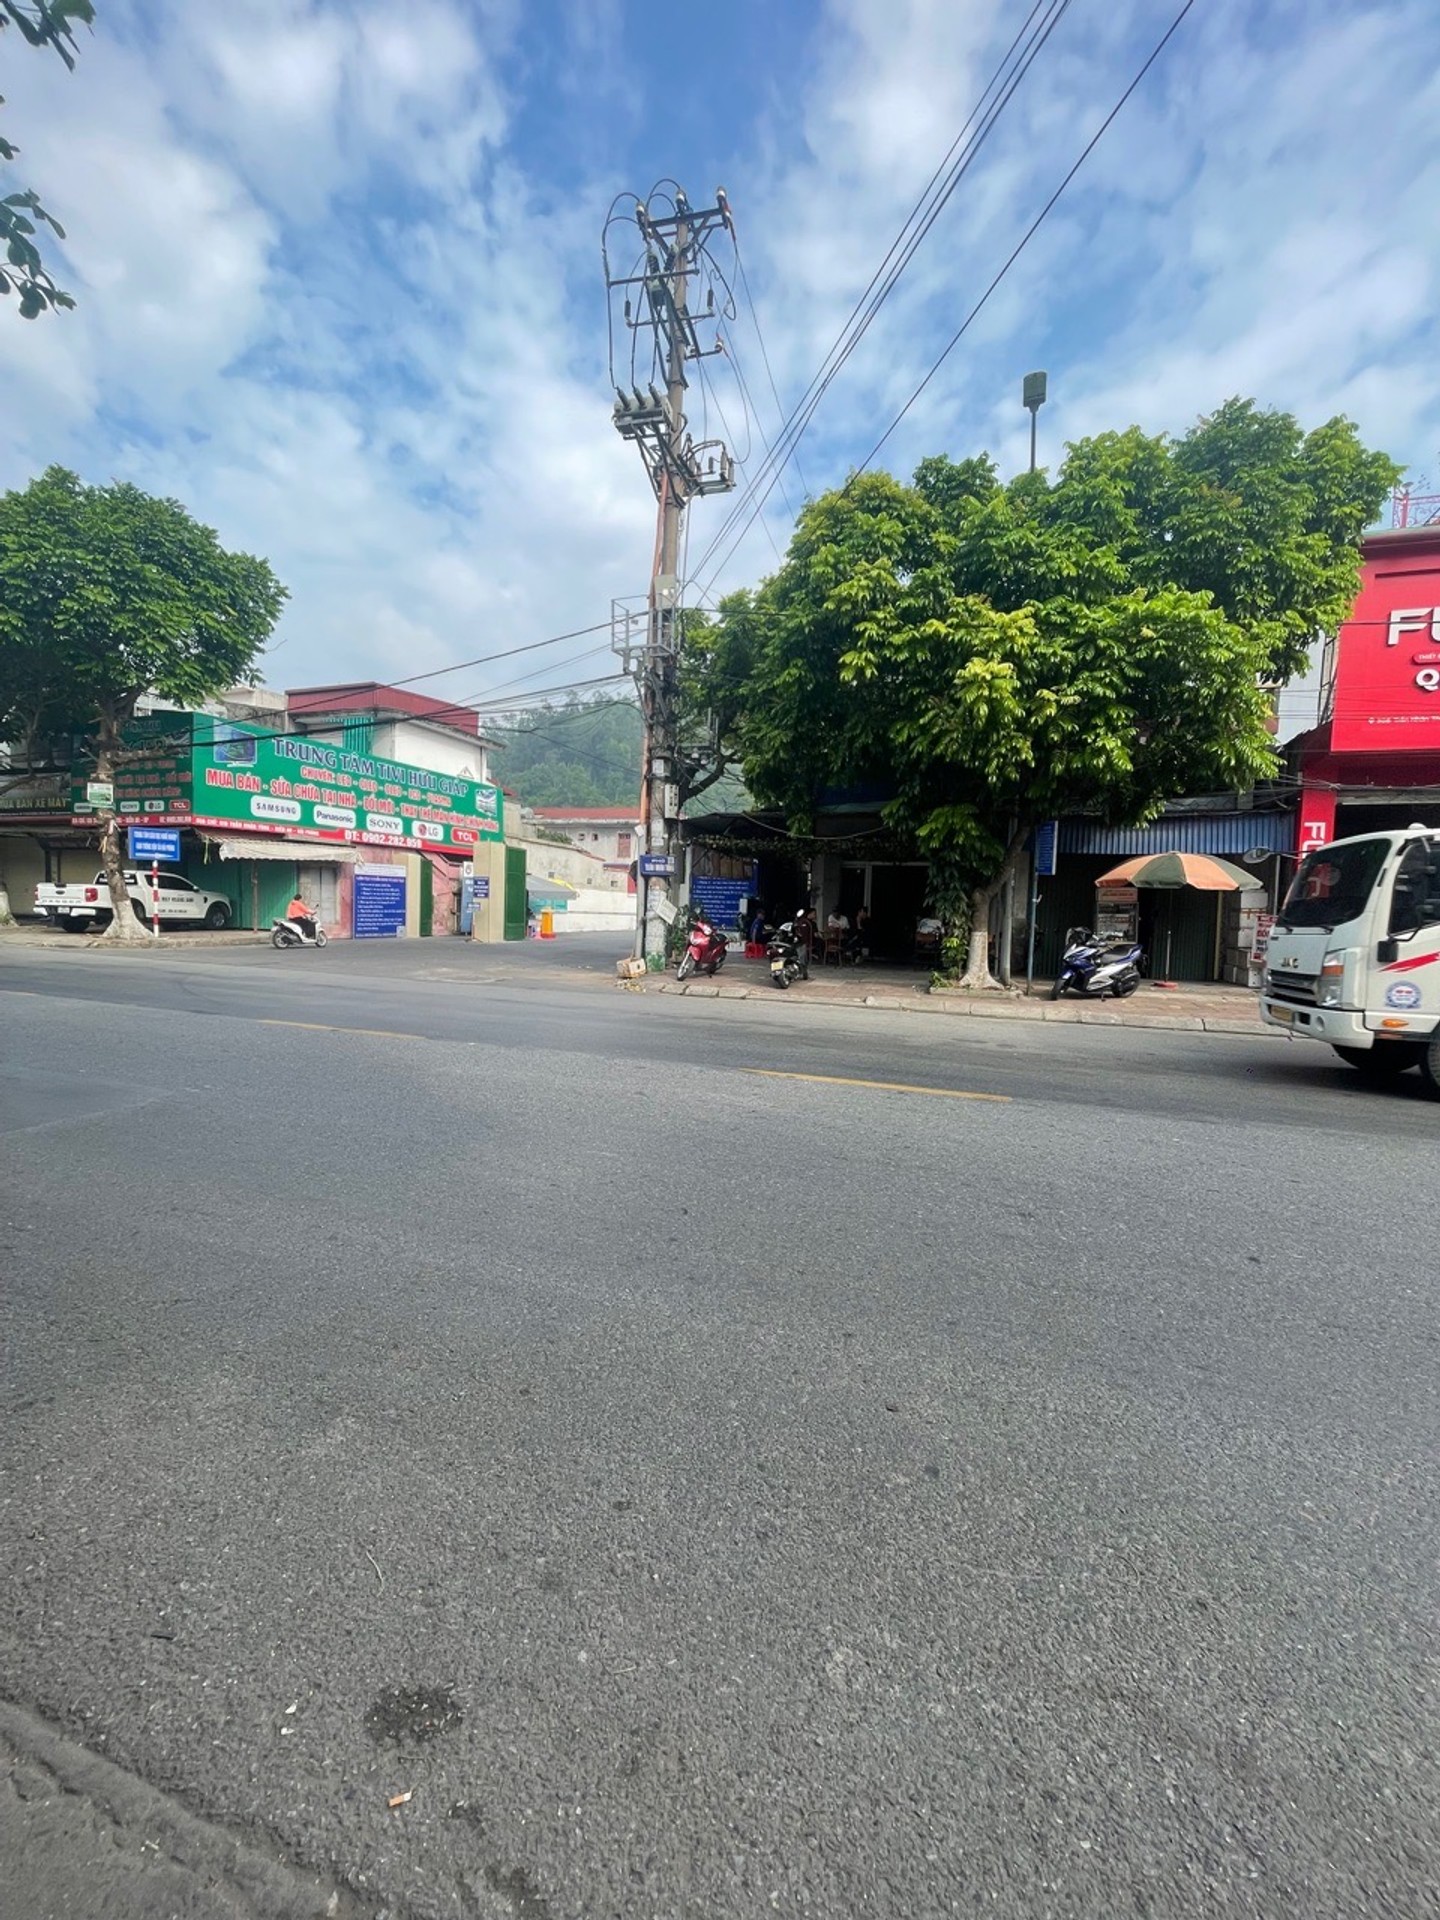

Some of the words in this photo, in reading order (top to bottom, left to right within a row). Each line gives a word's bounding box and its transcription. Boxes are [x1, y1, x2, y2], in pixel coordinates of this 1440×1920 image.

[272, 735, 336, 768] TRUNG
[340, 751, 374, 776] TÂM
[377, 763, 405, 784] TIVI
[439, 777, 469, 797] GIÁP
[206, 768, 234, 788] MUA
[236, 771, 260, 793] BÁN
[270, 776, 292, 798] SỬA
[321, 788, 337, 807] TẠI
[337, 790, 357, 808] NHÀ
[256, 802, 297, 815] SAMSUNG
[316, 810, 353, 824] Panasonic
[369, 818, 400, 830] SONY
[428, 828, 439, 837] LG
[457, 832, 474, 842] TCL
